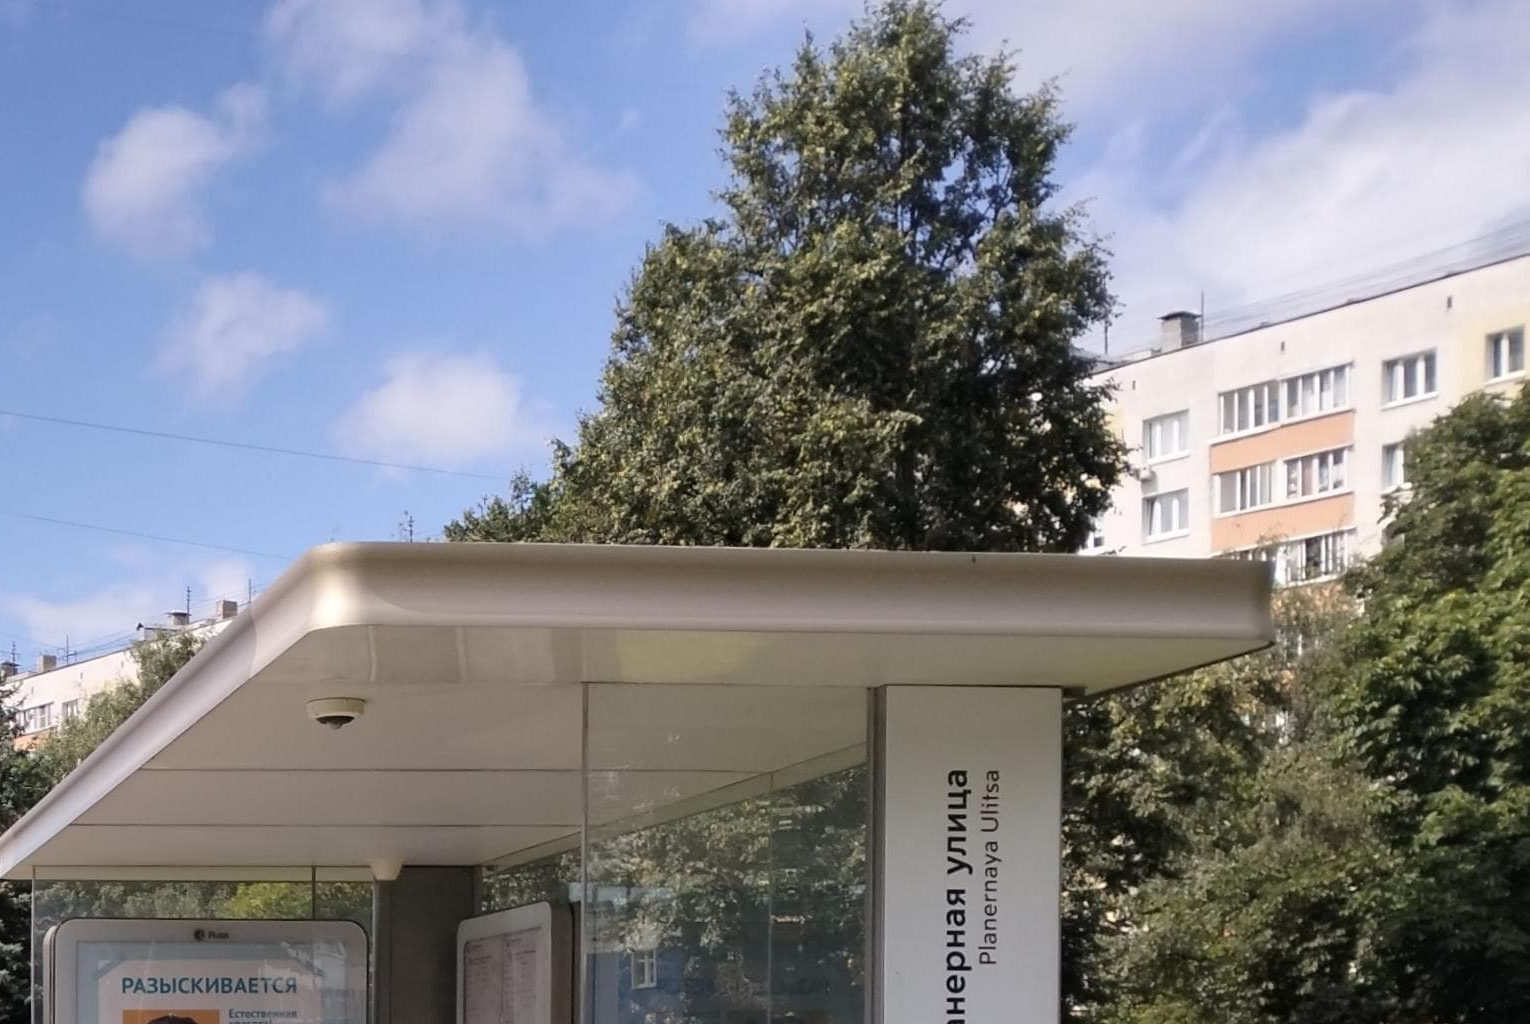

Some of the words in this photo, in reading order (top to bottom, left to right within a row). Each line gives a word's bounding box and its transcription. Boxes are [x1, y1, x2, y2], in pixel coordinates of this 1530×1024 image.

[947, 769, 973, 875] улица
[978, 769, 1000, 832] Ulitsa
[978, 841, 1002, 965] Planernaya
[122, 977, 297, 994] РАЗЫСКИВАЕТСЯ
[228, 1008, 297, 1019] Естественная
